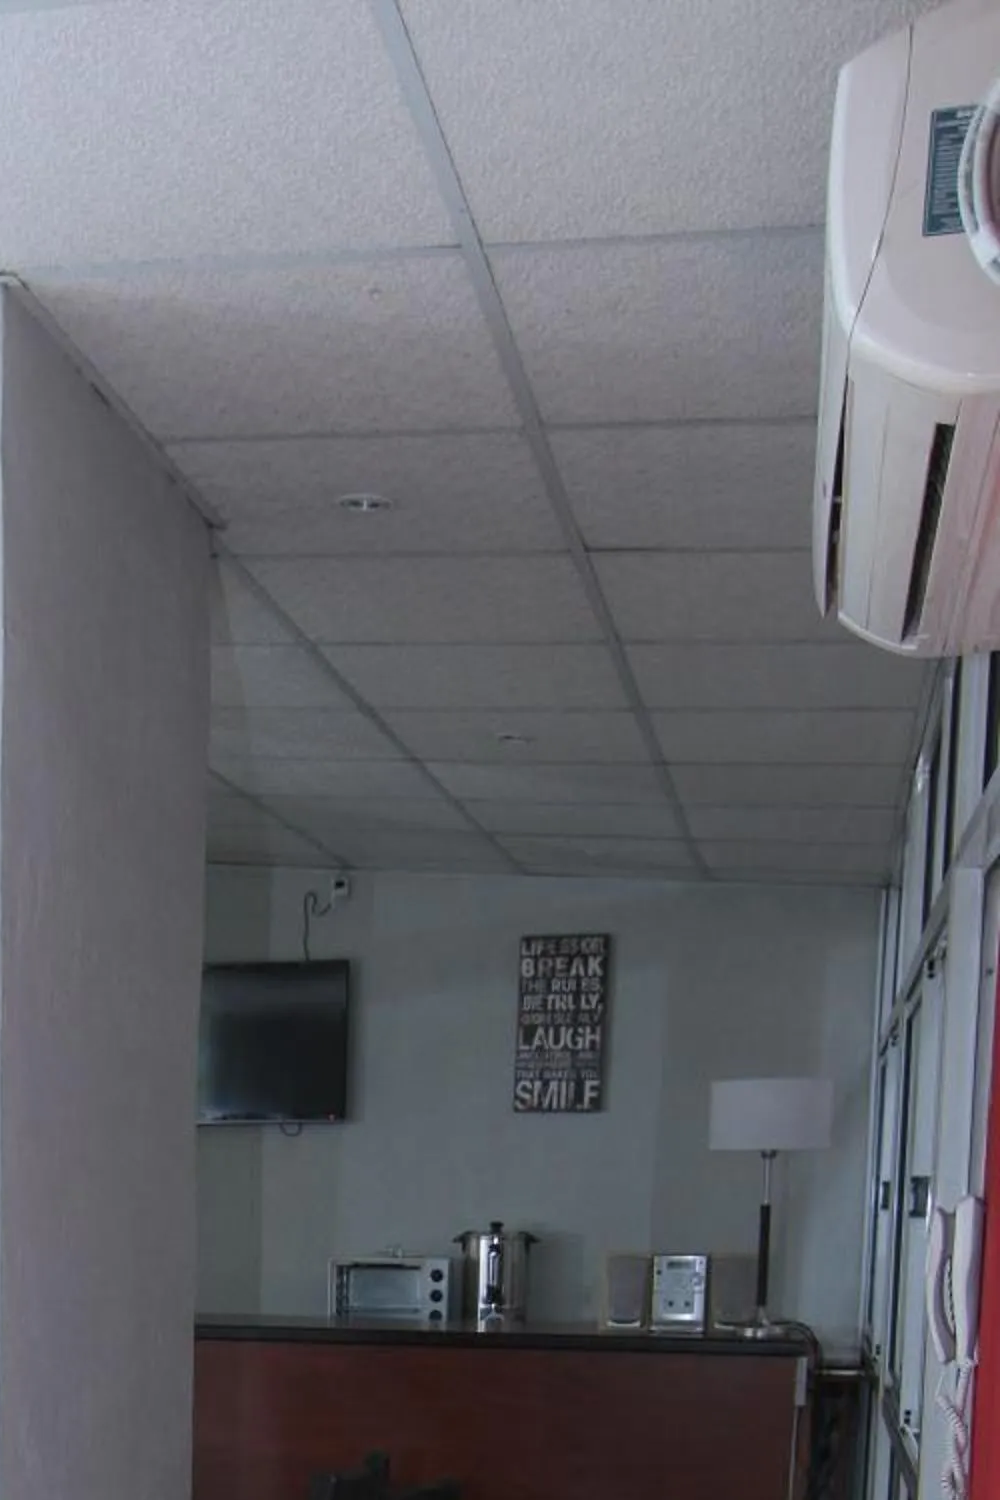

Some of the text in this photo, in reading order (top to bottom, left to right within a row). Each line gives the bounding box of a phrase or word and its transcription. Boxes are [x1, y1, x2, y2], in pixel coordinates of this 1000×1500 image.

[521, 956, 604, 977] BREAK
[518, 1026, 601, 1050] LAUGH
[514, 1080, 601, 1110] SMILE
